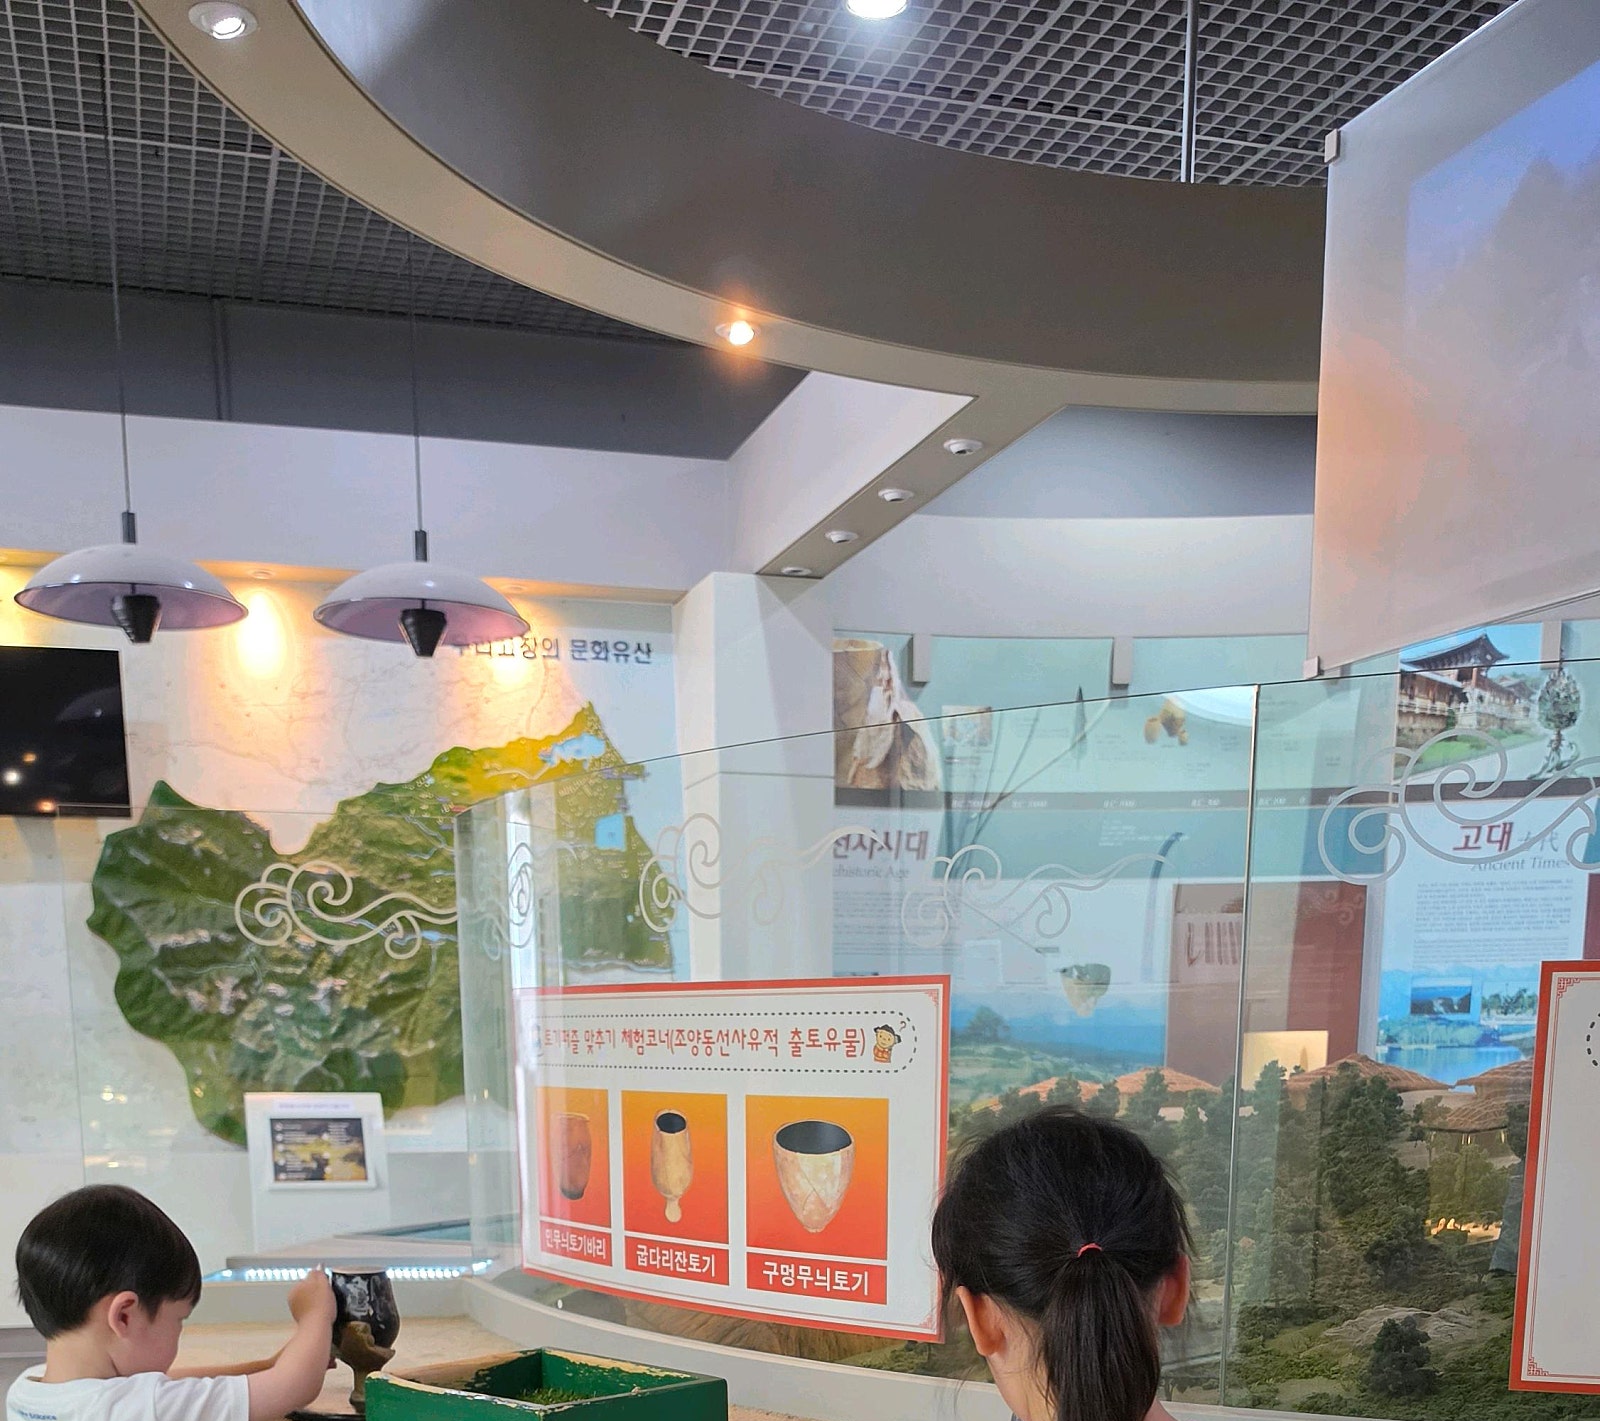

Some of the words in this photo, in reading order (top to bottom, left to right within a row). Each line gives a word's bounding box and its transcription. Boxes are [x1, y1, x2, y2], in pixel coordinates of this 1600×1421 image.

[570, 638, 652, 664] 문화유산
[1452, 821, 1514, 852] 고대
[583, 1028, 616, 1055] 맞추기
[788, 1027, 867, 1058] 출토유물)
[544, 1228, 607, 1260] 민무늬토기바리
[635, 1243, 716, 1278] 굽다리잔토기
[762, 1260, 870, 1296] 구멍무늬토기
